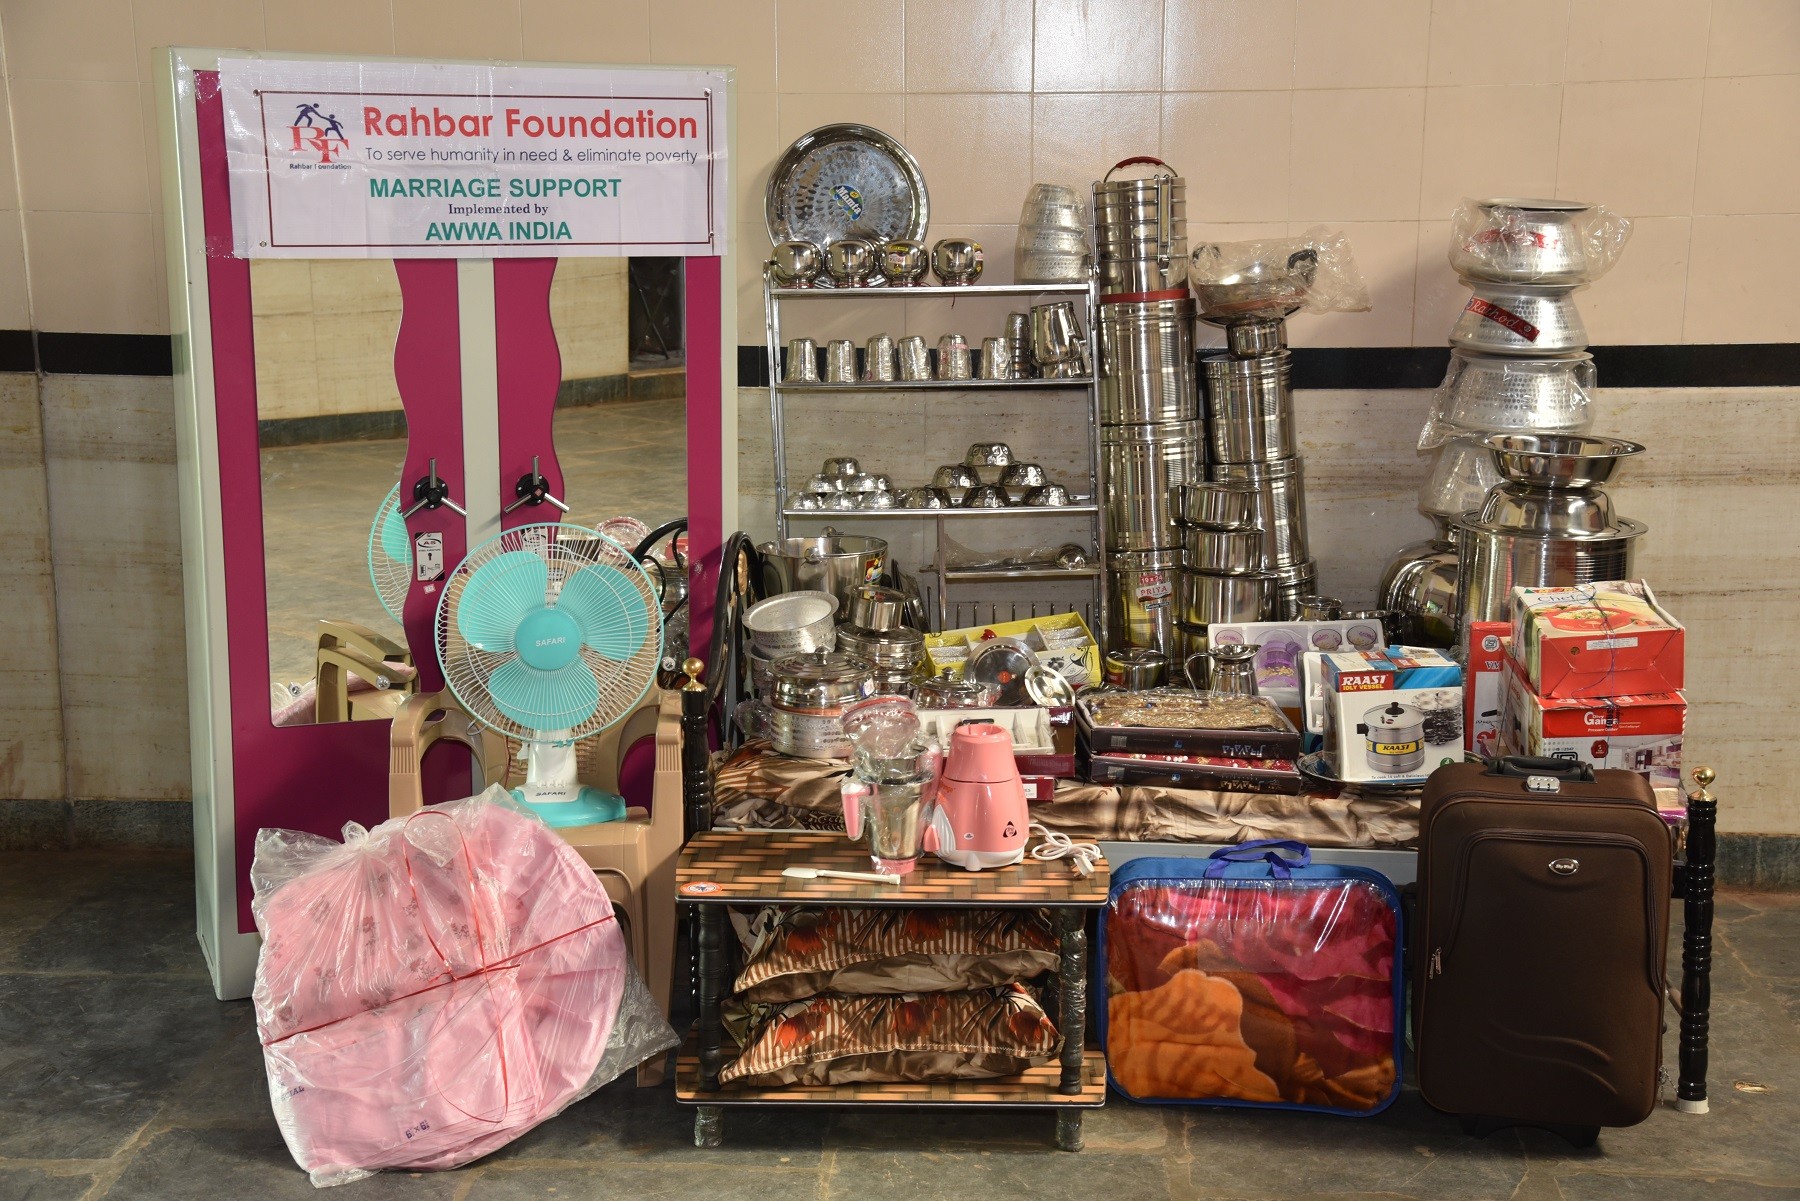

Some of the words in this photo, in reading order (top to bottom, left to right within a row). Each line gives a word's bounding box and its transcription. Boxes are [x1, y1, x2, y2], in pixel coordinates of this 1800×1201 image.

[364, 106, 493, 137] Rahbar
[505, 109, 697, 138] Foundation
[366, 148, 382, 160] To
[387, 150, 426, 161] serve
[430, 148, 499, 163] humanity
[503, 148, 515, 161] in
[520, 149, 557, 161] need
[562, 149, 573, 161] &
[577, 149, 641, 161] eliminate
[645, 150, 698, 164] poverty
[370, 179, 501, 197] MARRIAGE
[509, 179, 622, 197] SUPPORT
[836, 186, 862, 214] Mamta
[449, 204, 530, 215] Implemented
[534, 204, 548, 216] by
[425, 222, 502, 240] AWWA
[509, 222, 573, 240] INDIA
[1140, 585, 1168, 596] PRIYA
[535, 636, 566, 647] SAFARI
[1341, 674, 1386, 686] RAASI
